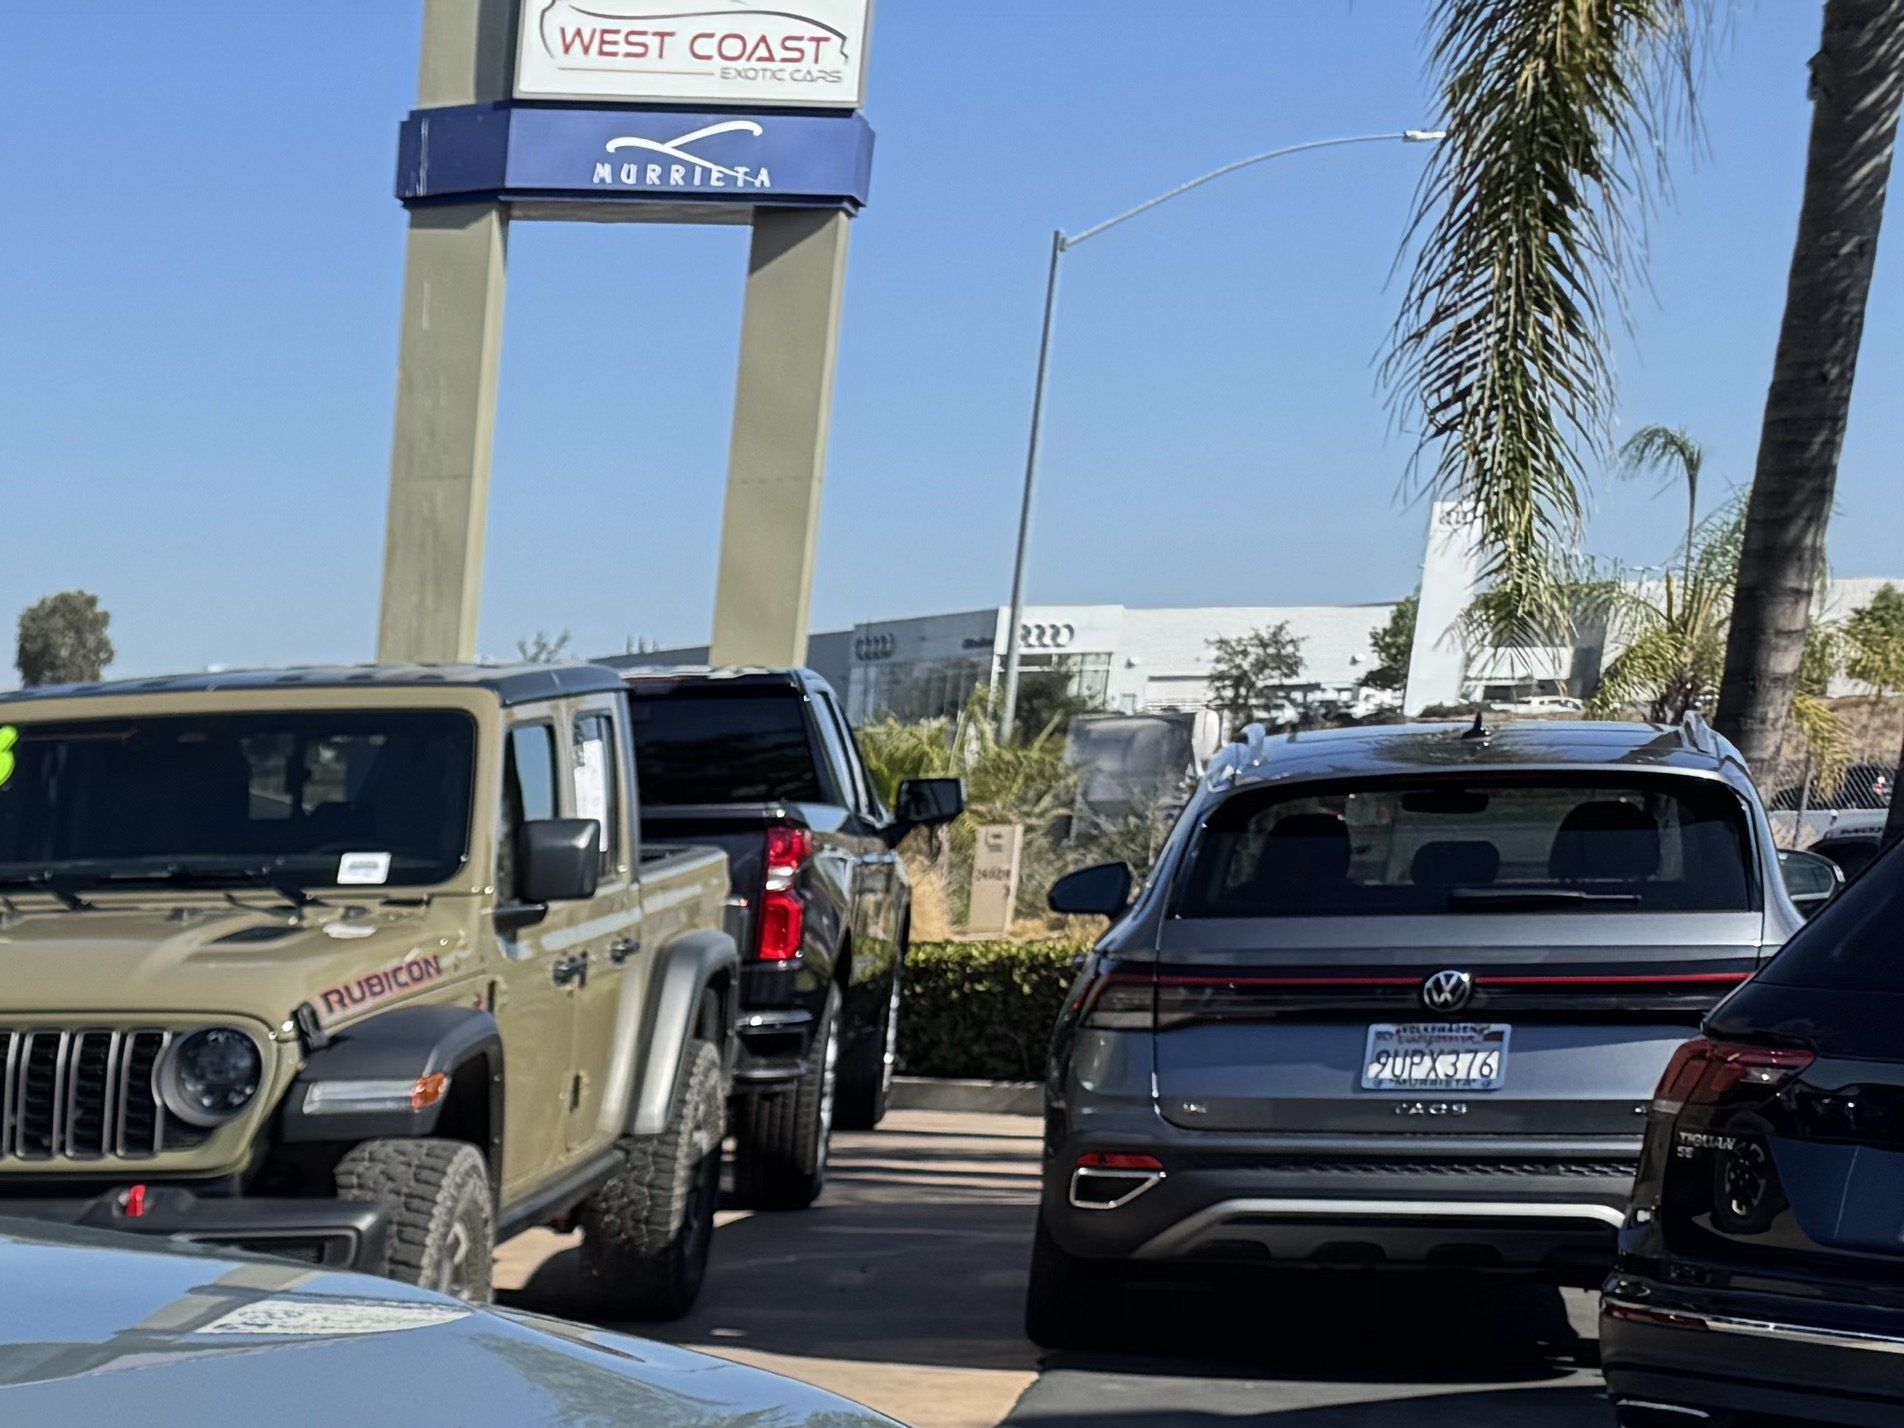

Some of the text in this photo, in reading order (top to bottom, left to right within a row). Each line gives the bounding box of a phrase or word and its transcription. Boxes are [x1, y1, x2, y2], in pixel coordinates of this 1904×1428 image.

[559, 26, 832, 64] WEST COAST
[720, 66, 843, 83] EXOTIC CARS
[592, 161, 772, 189] MURRIETA
[320, 954, 441, 1015] RUBICON
[1374, 1049, 1494, 1080] 9UPX376
[1679, 1132, 1736, 1150] TIGUAN
